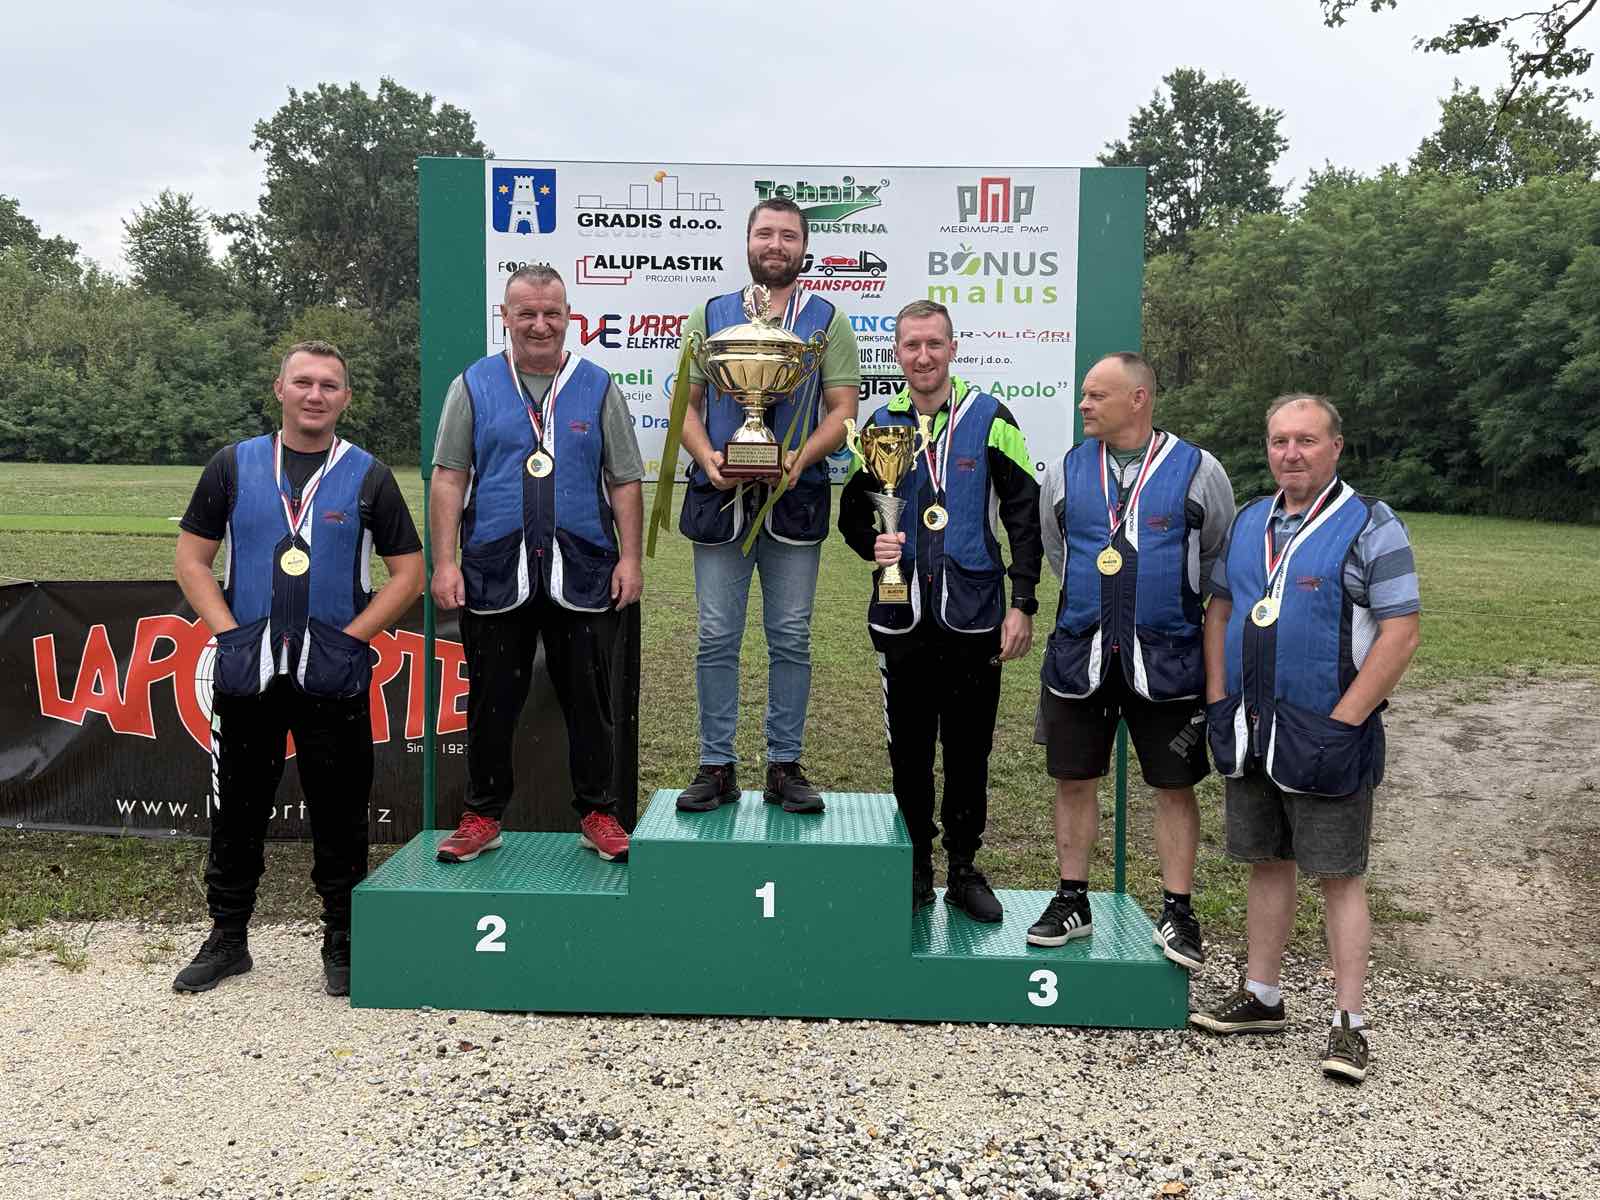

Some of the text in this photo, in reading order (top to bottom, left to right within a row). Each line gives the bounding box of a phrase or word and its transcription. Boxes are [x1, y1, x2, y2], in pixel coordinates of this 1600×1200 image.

[577, 213, 722, 230] GRADIS d.o.o.
[807, 223, 889, 234] DUSTRIJA
[594, 255, 723, 271] ALUPLASTIK
[646, 274, 682, 283] PROZORI
[691, 276, 717, 284] VRATA
[928, 278, 1058, 304] malus
[856, 335, 896, 343] ORKSPAC
[755, 882, 776, 918] 1
[475, 915, 507, 953] 2
[1027, 969, 1058, 1006] 3
